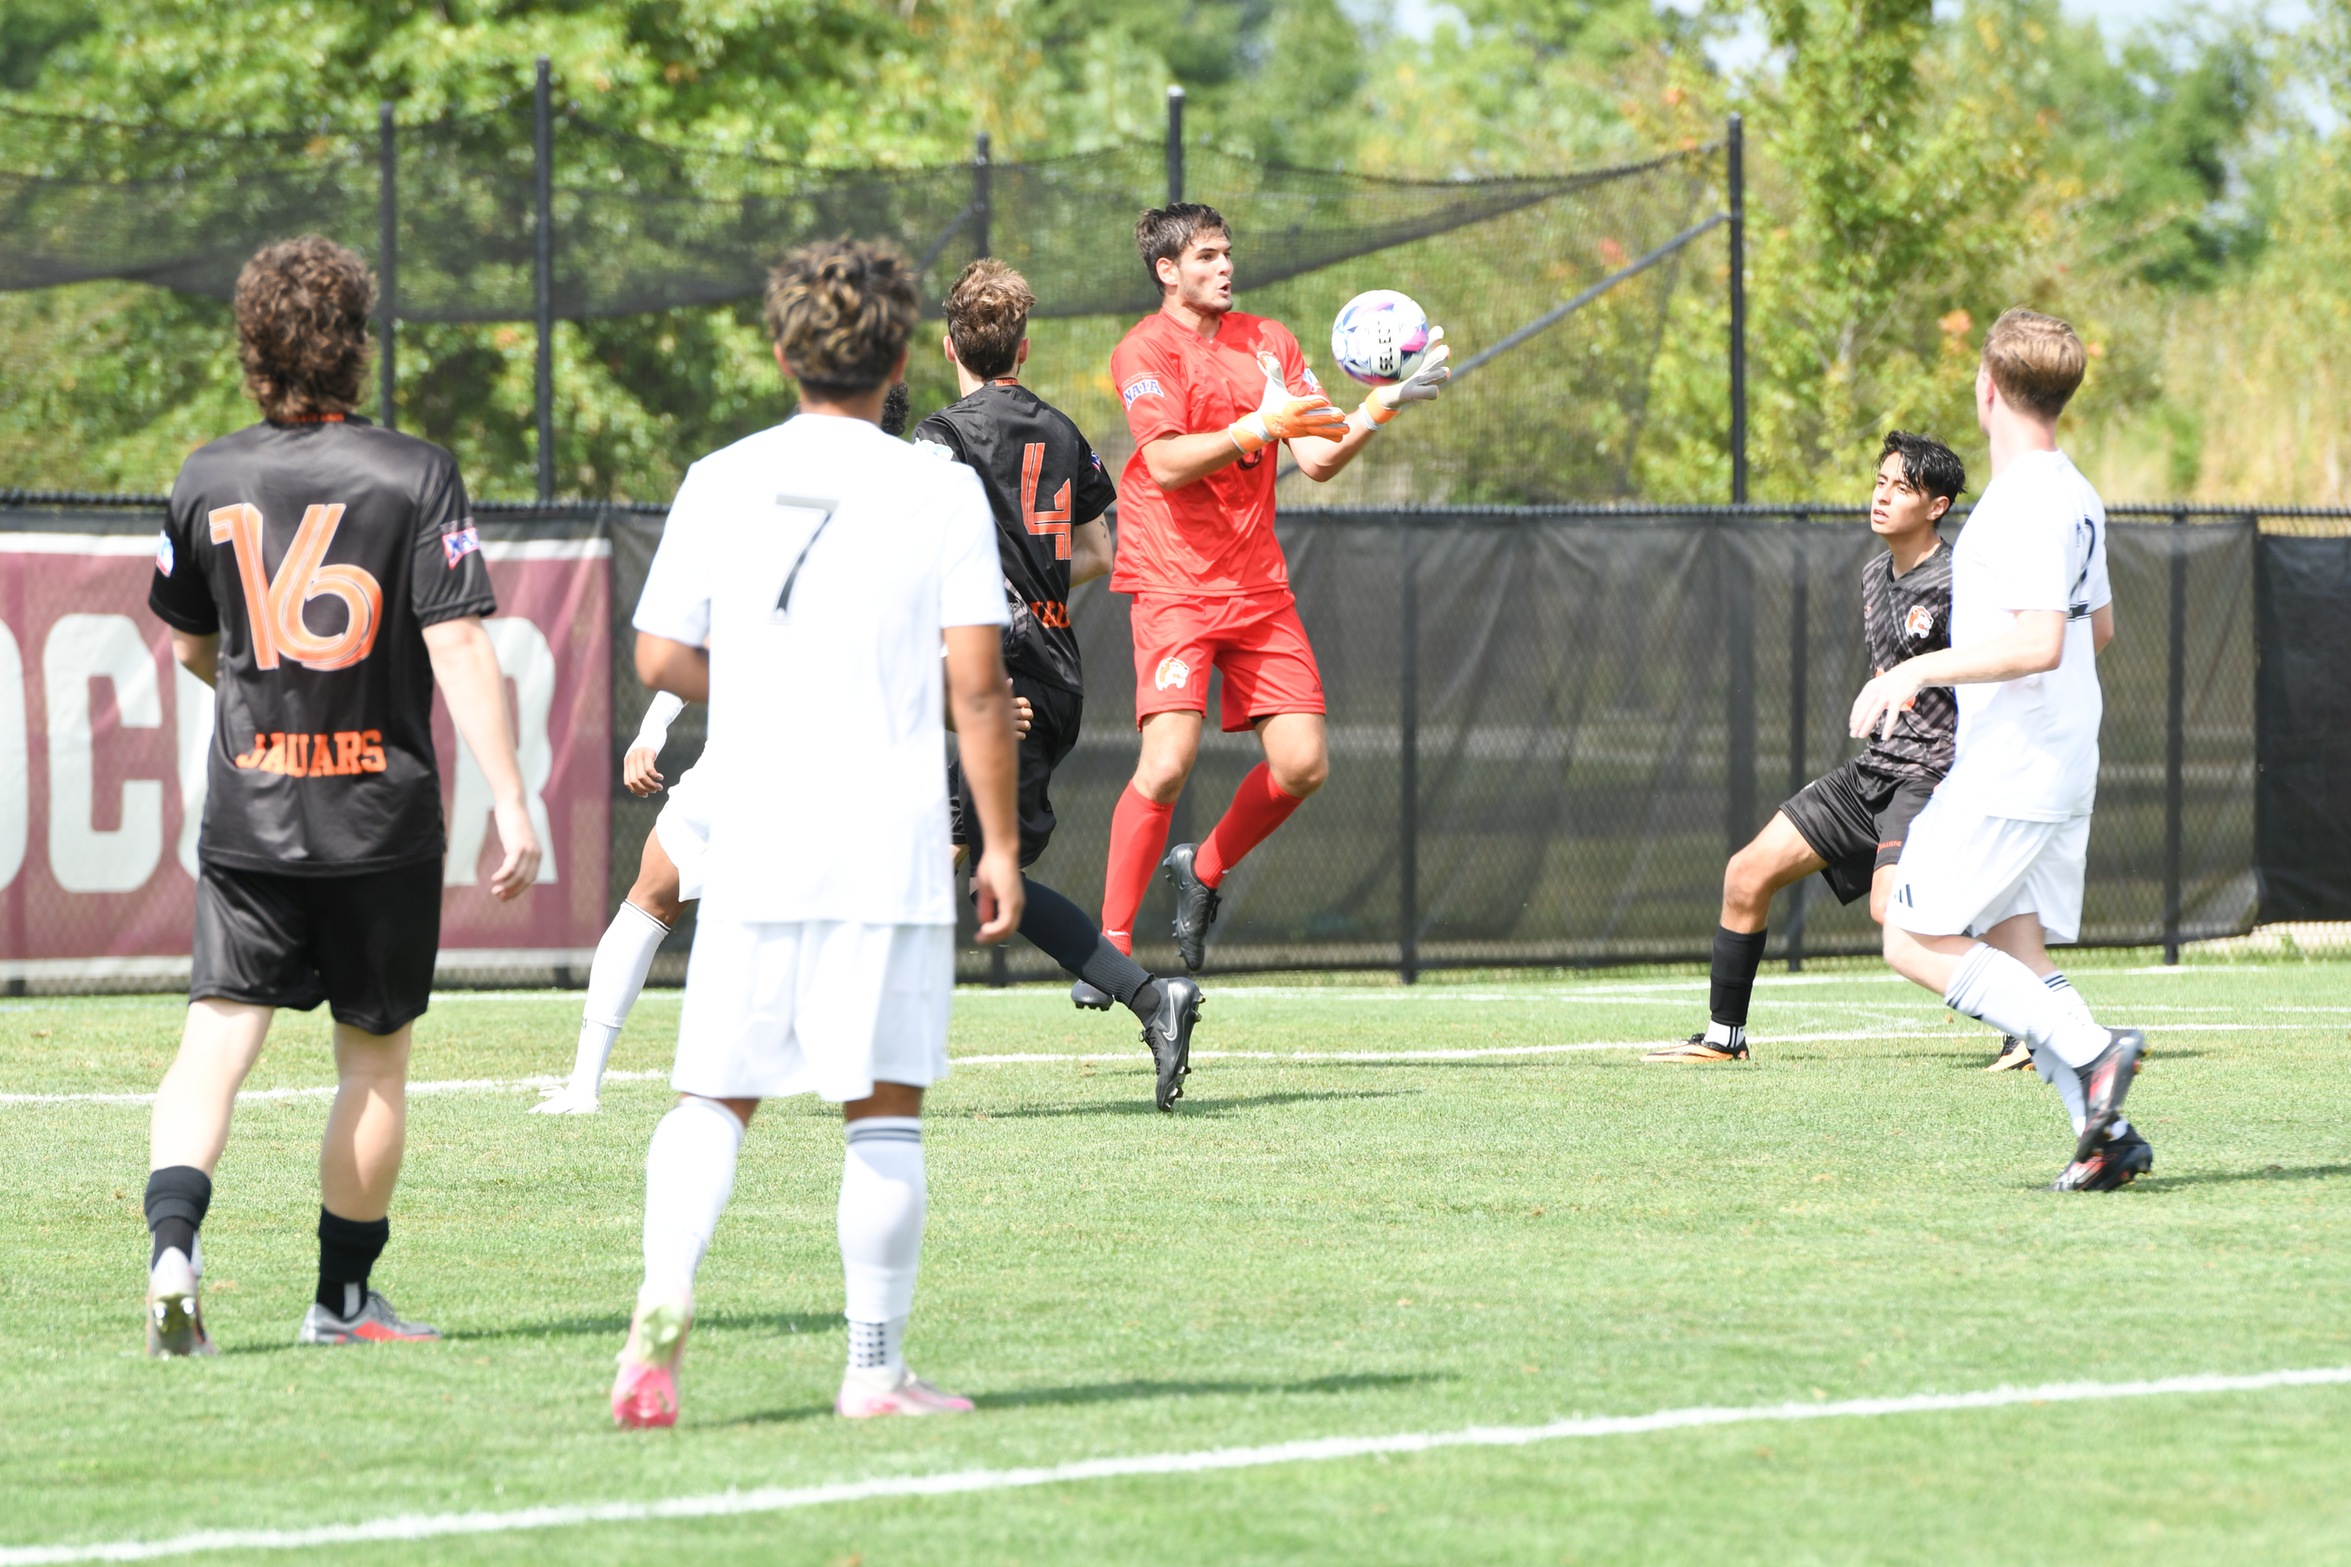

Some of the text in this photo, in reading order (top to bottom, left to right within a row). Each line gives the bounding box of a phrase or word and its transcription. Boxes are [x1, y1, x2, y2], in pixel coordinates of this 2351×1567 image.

[1125, 381, 1162, 405] NAIA
[768, 493, 839, 624] 7
[1020, 442, 1072, 561] 4
[208, 503, 384, 671] 16
